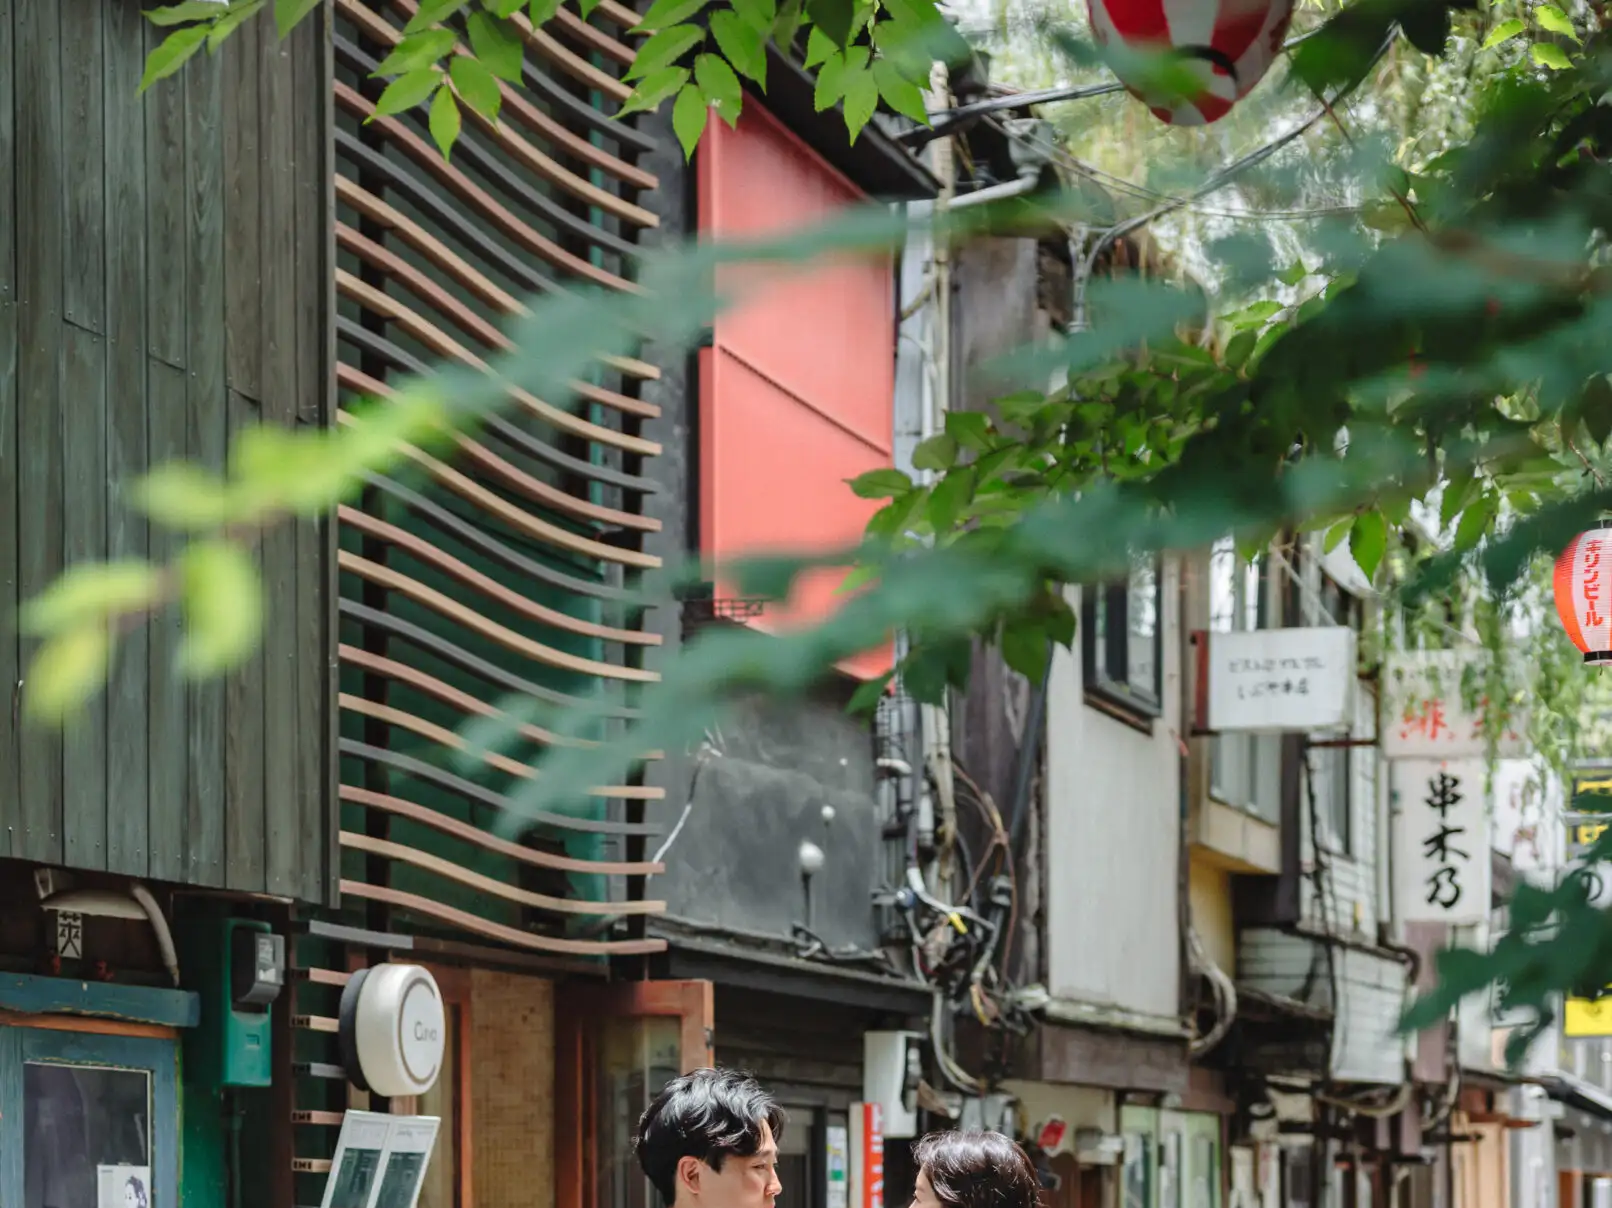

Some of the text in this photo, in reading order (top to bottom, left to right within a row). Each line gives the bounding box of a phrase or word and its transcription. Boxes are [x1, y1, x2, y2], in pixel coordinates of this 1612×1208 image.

[1583, 539, 1604, 627] キリンビール
[1423, 772, 1470, 909] 串木乃
